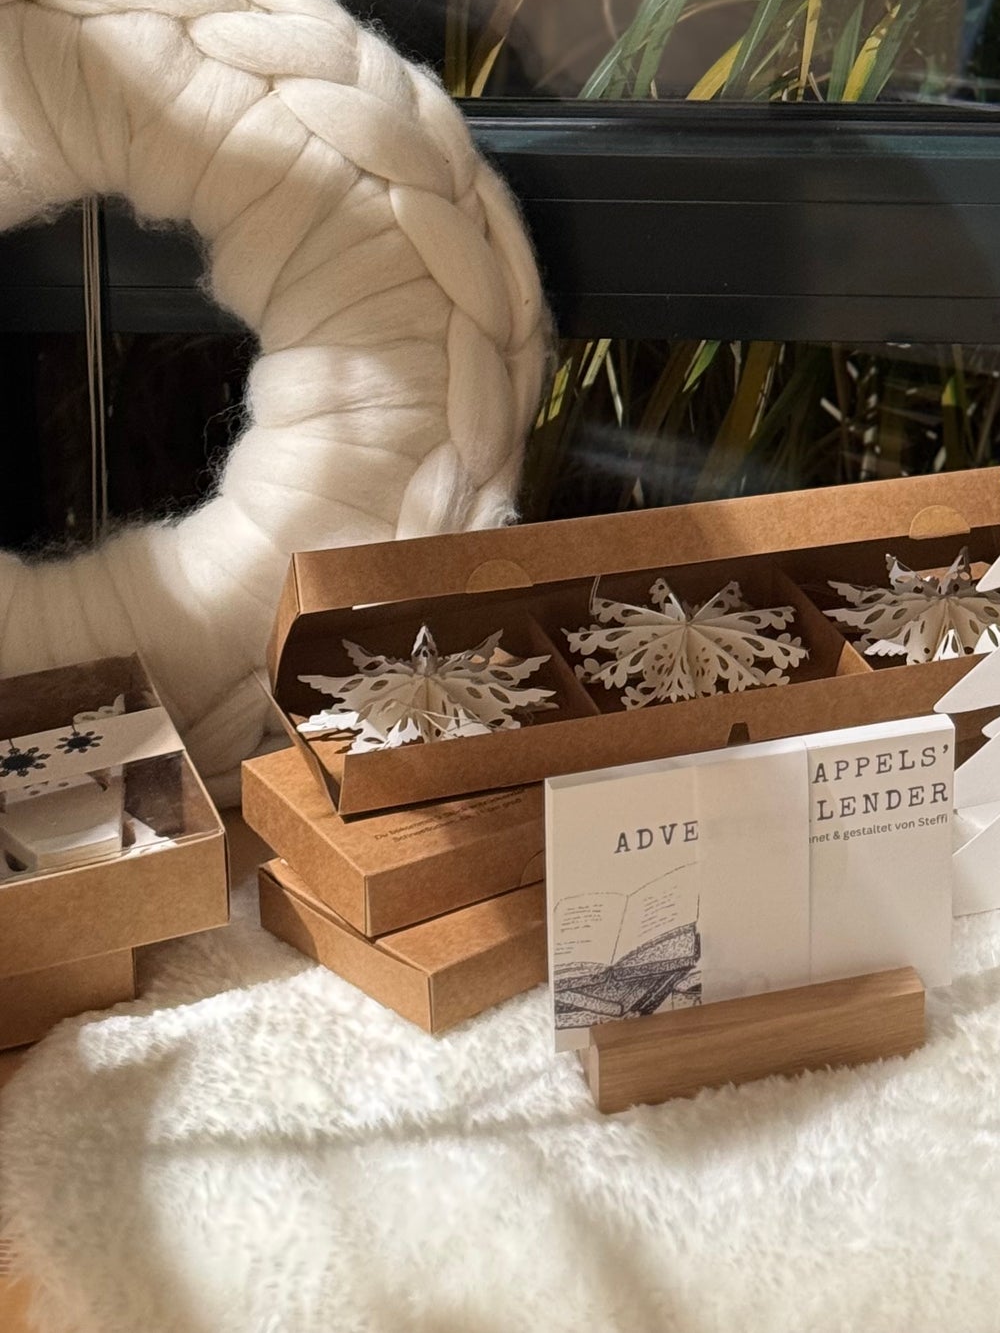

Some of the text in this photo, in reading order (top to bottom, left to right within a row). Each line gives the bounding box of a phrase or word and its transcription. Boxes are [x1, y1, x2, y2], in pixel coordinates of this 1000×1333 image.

[815, 782, 949, 822] LENDER
[833, 830, 841, 841] &
[843, 823, 892, 841] gestaltet
[895, 818, 916, 831] von
[918, 813, 948, 827] Steffi
